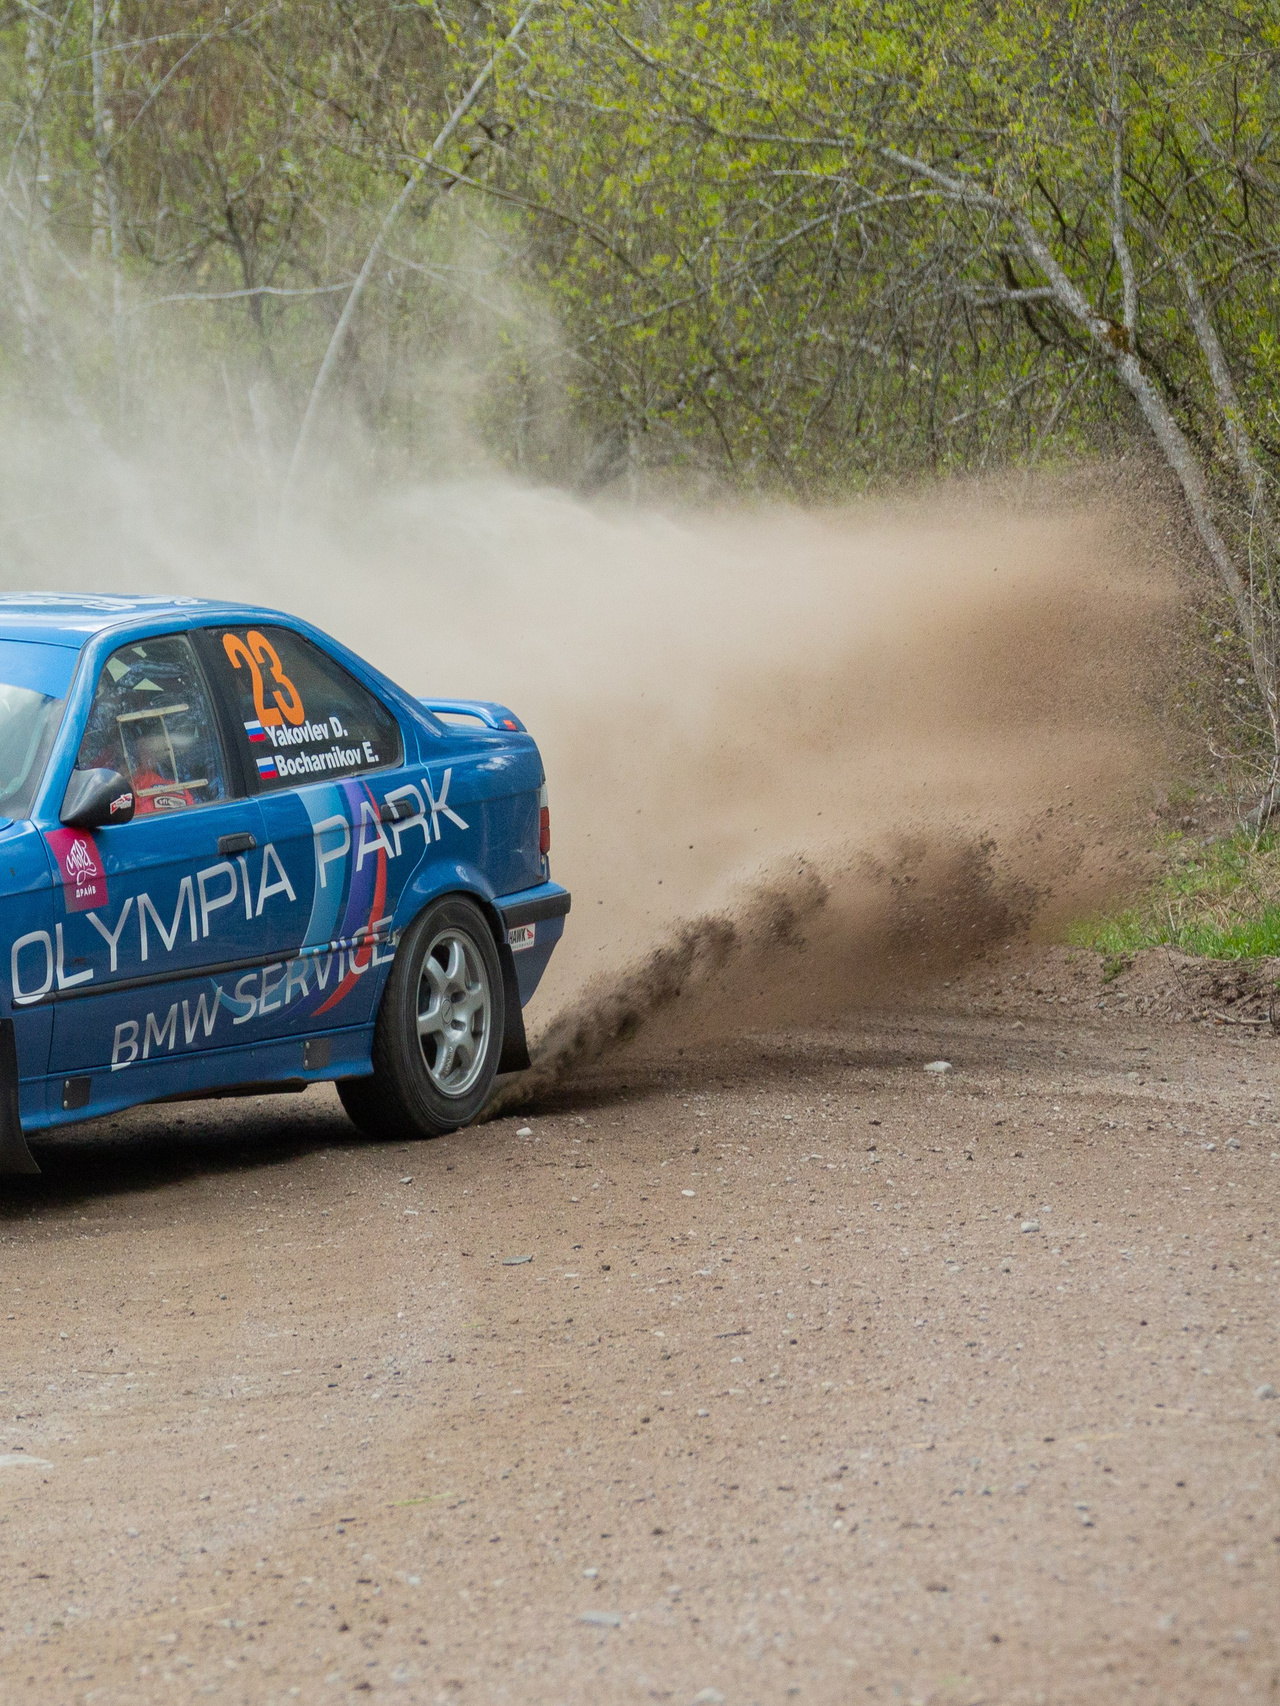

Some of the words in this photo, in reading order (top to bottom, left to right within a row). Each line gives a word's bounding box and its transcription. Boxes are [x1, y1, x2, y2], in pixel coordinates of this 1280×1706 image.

[222, 630, 305, 727] 23
[264, 720, 330, 747] Yakovlev
[329, 716, 349, 738] D.
[274, 746, 362, 776] Bocharnikov
[362, 741, 380, 763] E.
[11, 842, 297, 1004] OLYMPIA
[313, 768, 469, 888] PARK
[75, 884, 97, 899] ДРАЙВ
[111, 985, 223, 1071] BMW
[233, 915, 396, 1025] SERVICE
